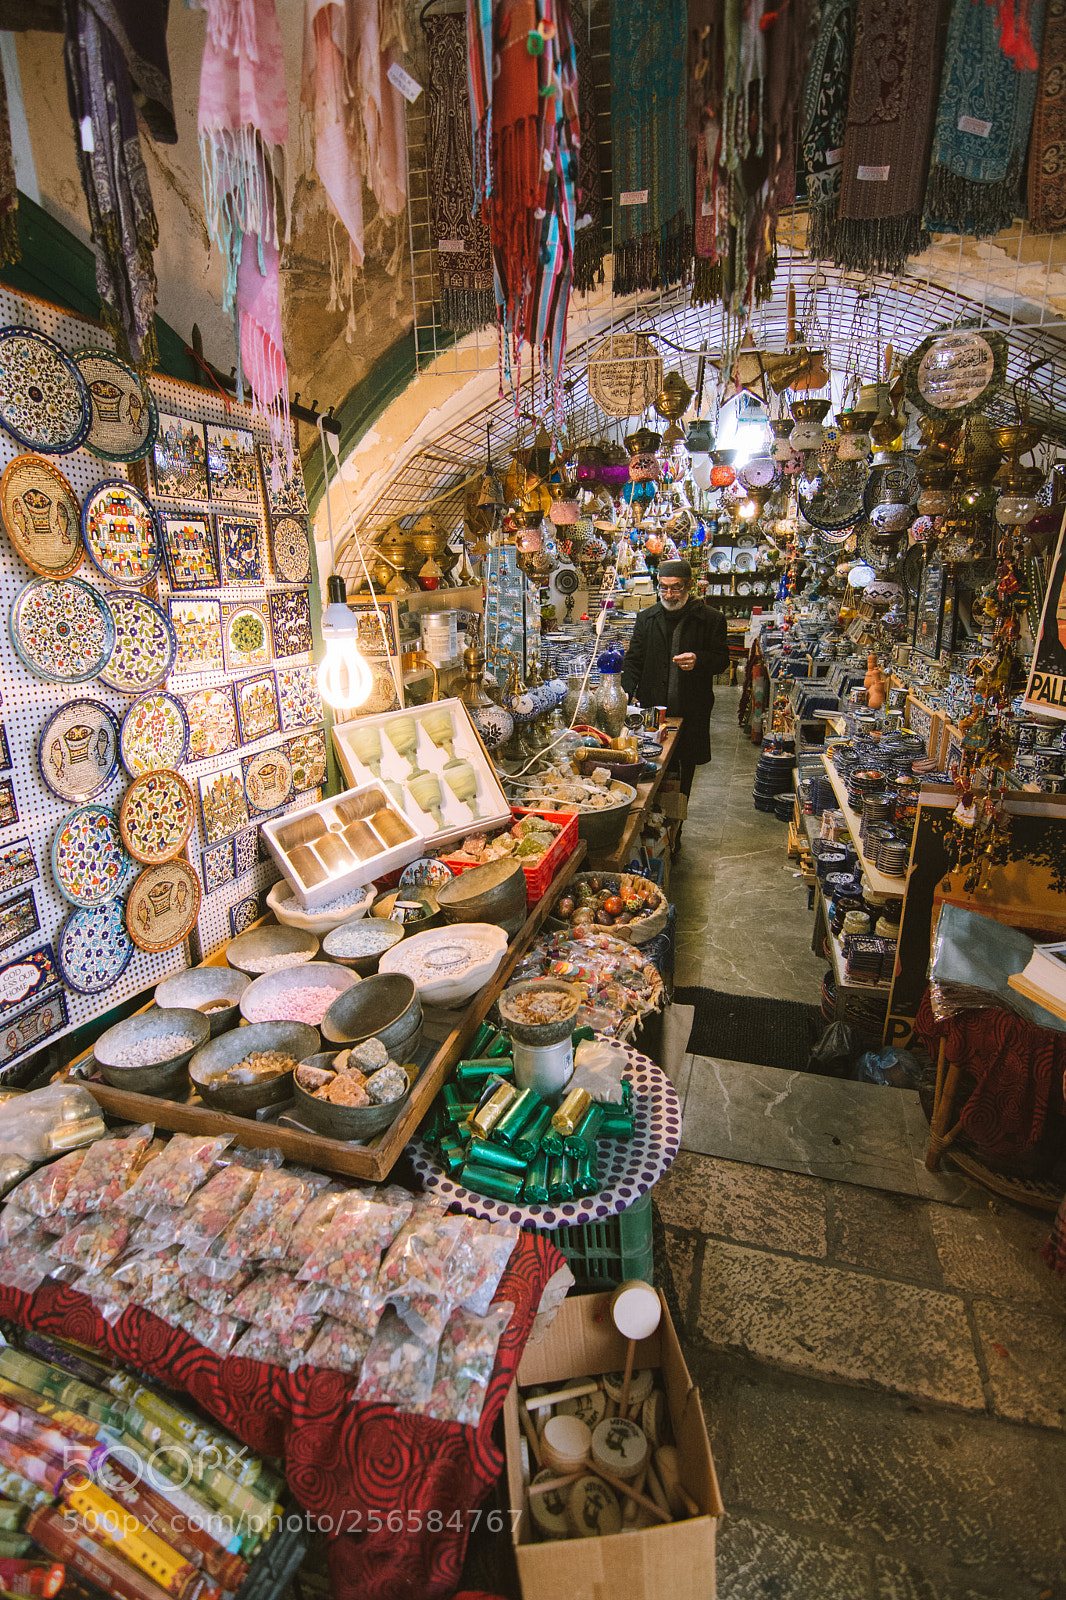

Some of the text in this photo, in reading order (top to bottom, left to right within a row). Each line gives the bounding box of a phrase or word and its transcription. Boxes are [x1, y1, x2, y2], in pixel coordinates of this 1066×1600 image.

[3, 969, 21, 982] GOD
[19, 969, 36, 982] OUR
[5, 982, 27, 998] HOME
